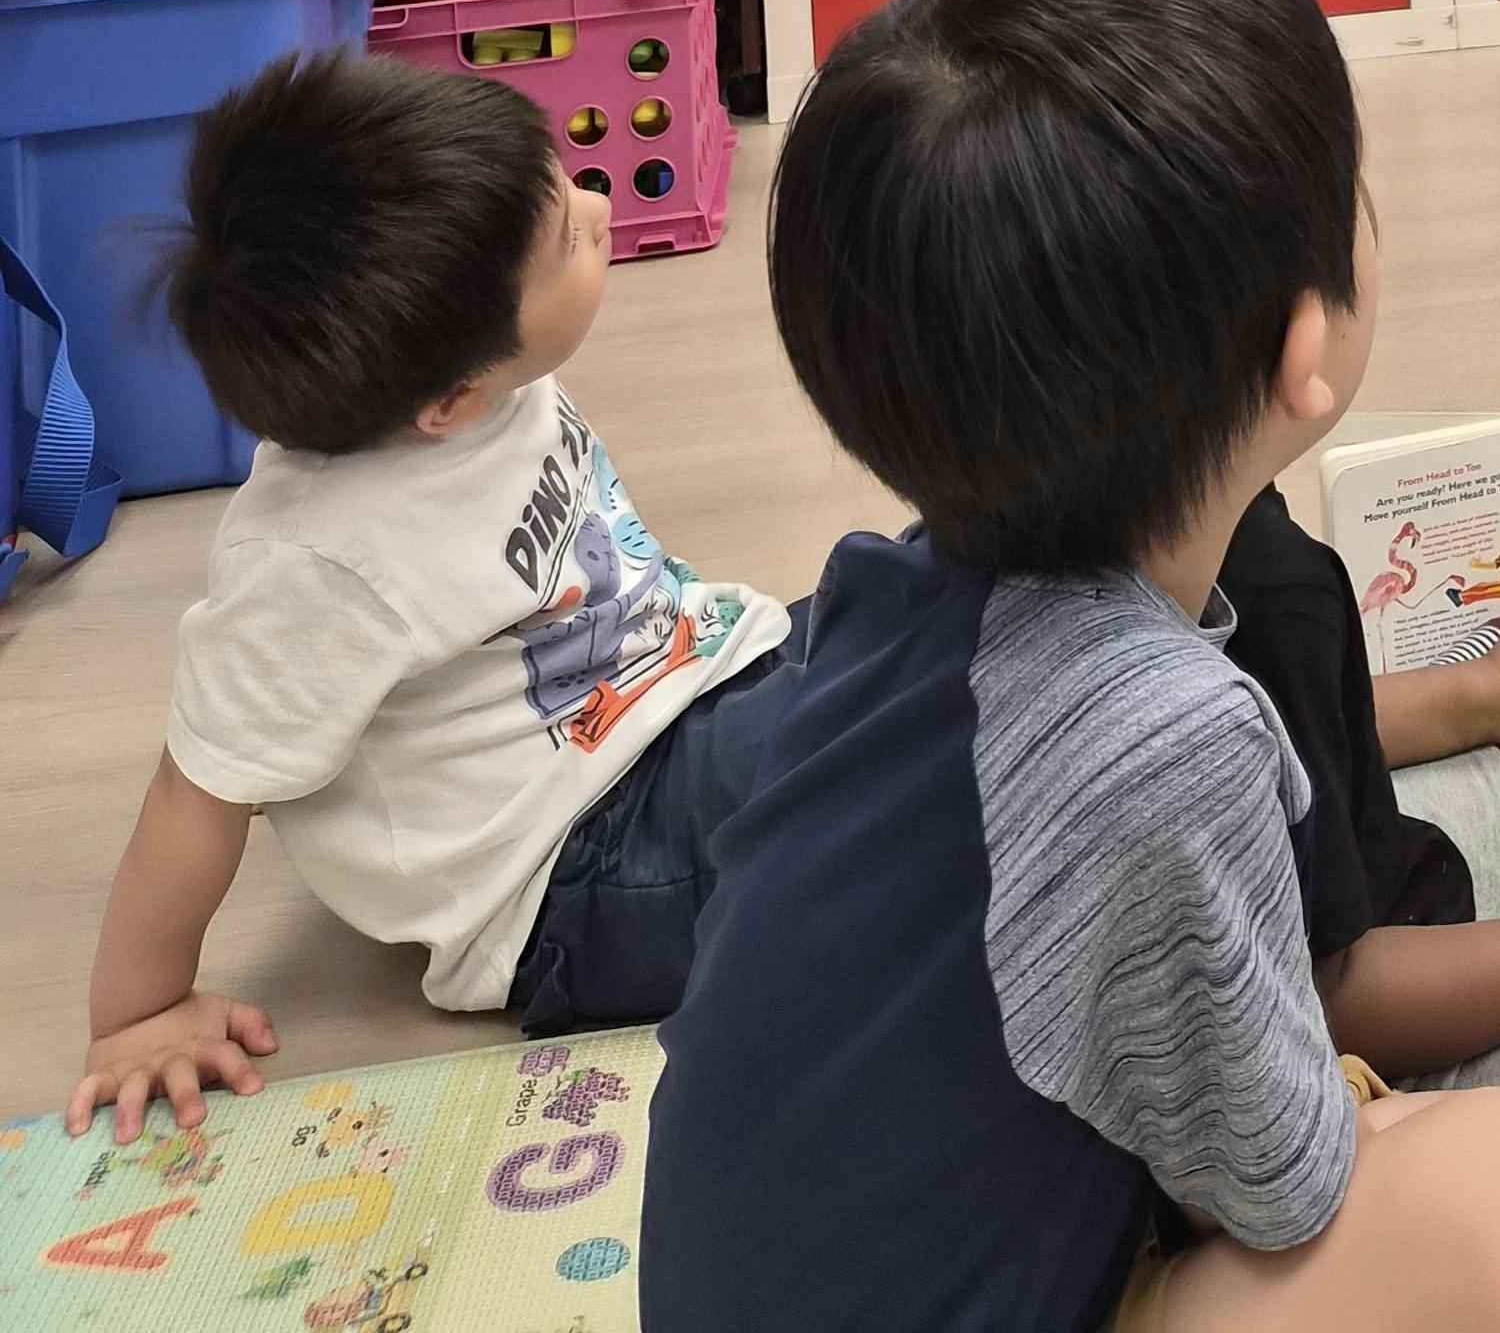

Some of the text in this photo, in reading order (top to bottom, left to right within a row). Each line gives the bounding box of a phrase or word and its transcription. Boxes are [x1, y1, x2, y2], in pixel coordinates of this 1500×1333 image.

[1376, 497, 1394, 508] Are
[1396, 493, 1414, 505] you
[1416, 484, 1446, 500] ready?
[1448, 479, 1472, 493] Here
[1474, 475, 1488, 485] we
[1397, 462, 1482, 488] From Head to Toe
[1364, 511, 1390, 523] Move
[1392, 499, 1430, 519] yourself
[1431, 497, 1457, 509] From
[1459, 487, 1484, 502] Head
[1486, 485, 1497, 495] to
[506, 1079, 538, 1128] Grape
[485, 1131, 626, 1213] G
[41, 1194, 200, 1275] A
[238, 1171, 396, 1259] D
